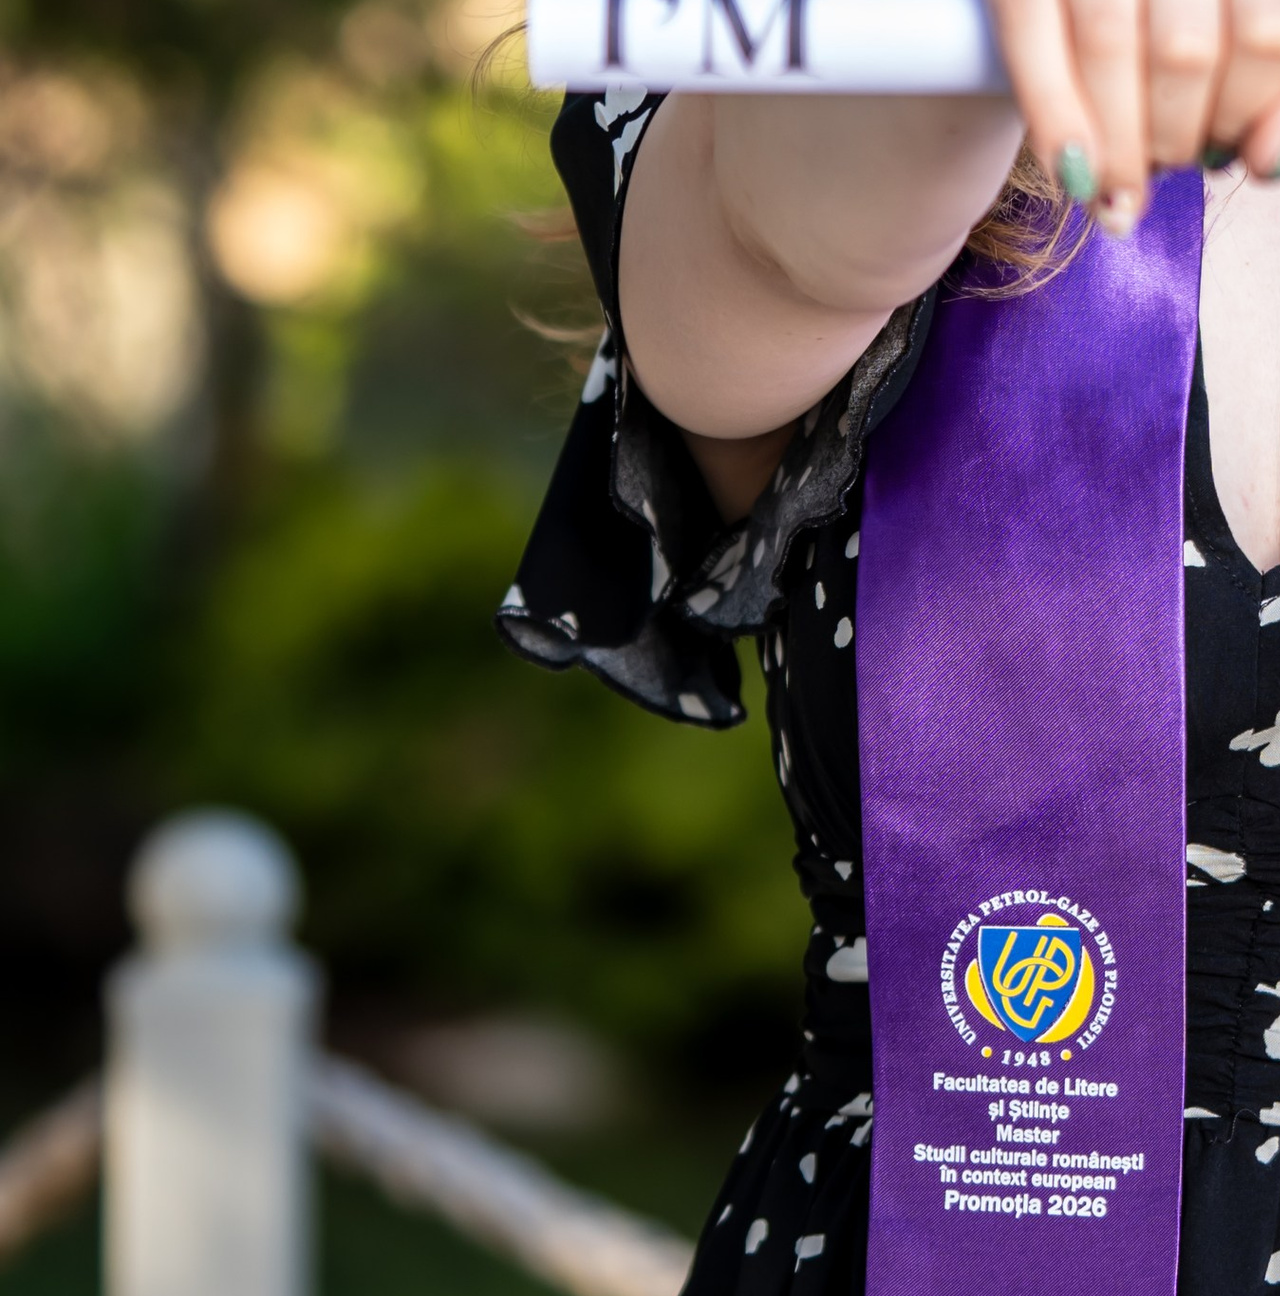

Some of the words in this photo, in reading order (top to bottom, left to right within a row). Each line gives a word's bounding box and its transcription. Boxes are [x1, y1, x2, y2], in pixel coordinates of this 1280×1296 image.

[978, 889, 1100, 933] PETROL-GAZE
[1094, 930, 1117, 965] DIN
[940, 912, 982, 1046] UNIVERSITATEA
[1076, 968, 1118, 1050] PLOIESTI
[1001, 1049, 1052, 1068] 1948
[933, 1072, 1030, 1095] Facultatea
[1035, 1076, 1059, 1095] de
[1064, 1077, 1119, 1097] Litere
[988, 1099, 1004, 1121] și
[1008, 1099, 1070, 1124] Științe
[996, 1124, 1060, 1144] Master
[913, 1143, 966, 1163] Studii
[970, 1147, 1047, 1167] culturale
[1052, 1150, 1144, 1175] românești
[939, 1164, 957, 1183] în
[961, 1168, 1027, 1186] context
[1031, 1174, 1116, 1192] european
[944, 1189, 1041, 1219] Promoția
[1047, 1194, 1108, 1218] 2026
